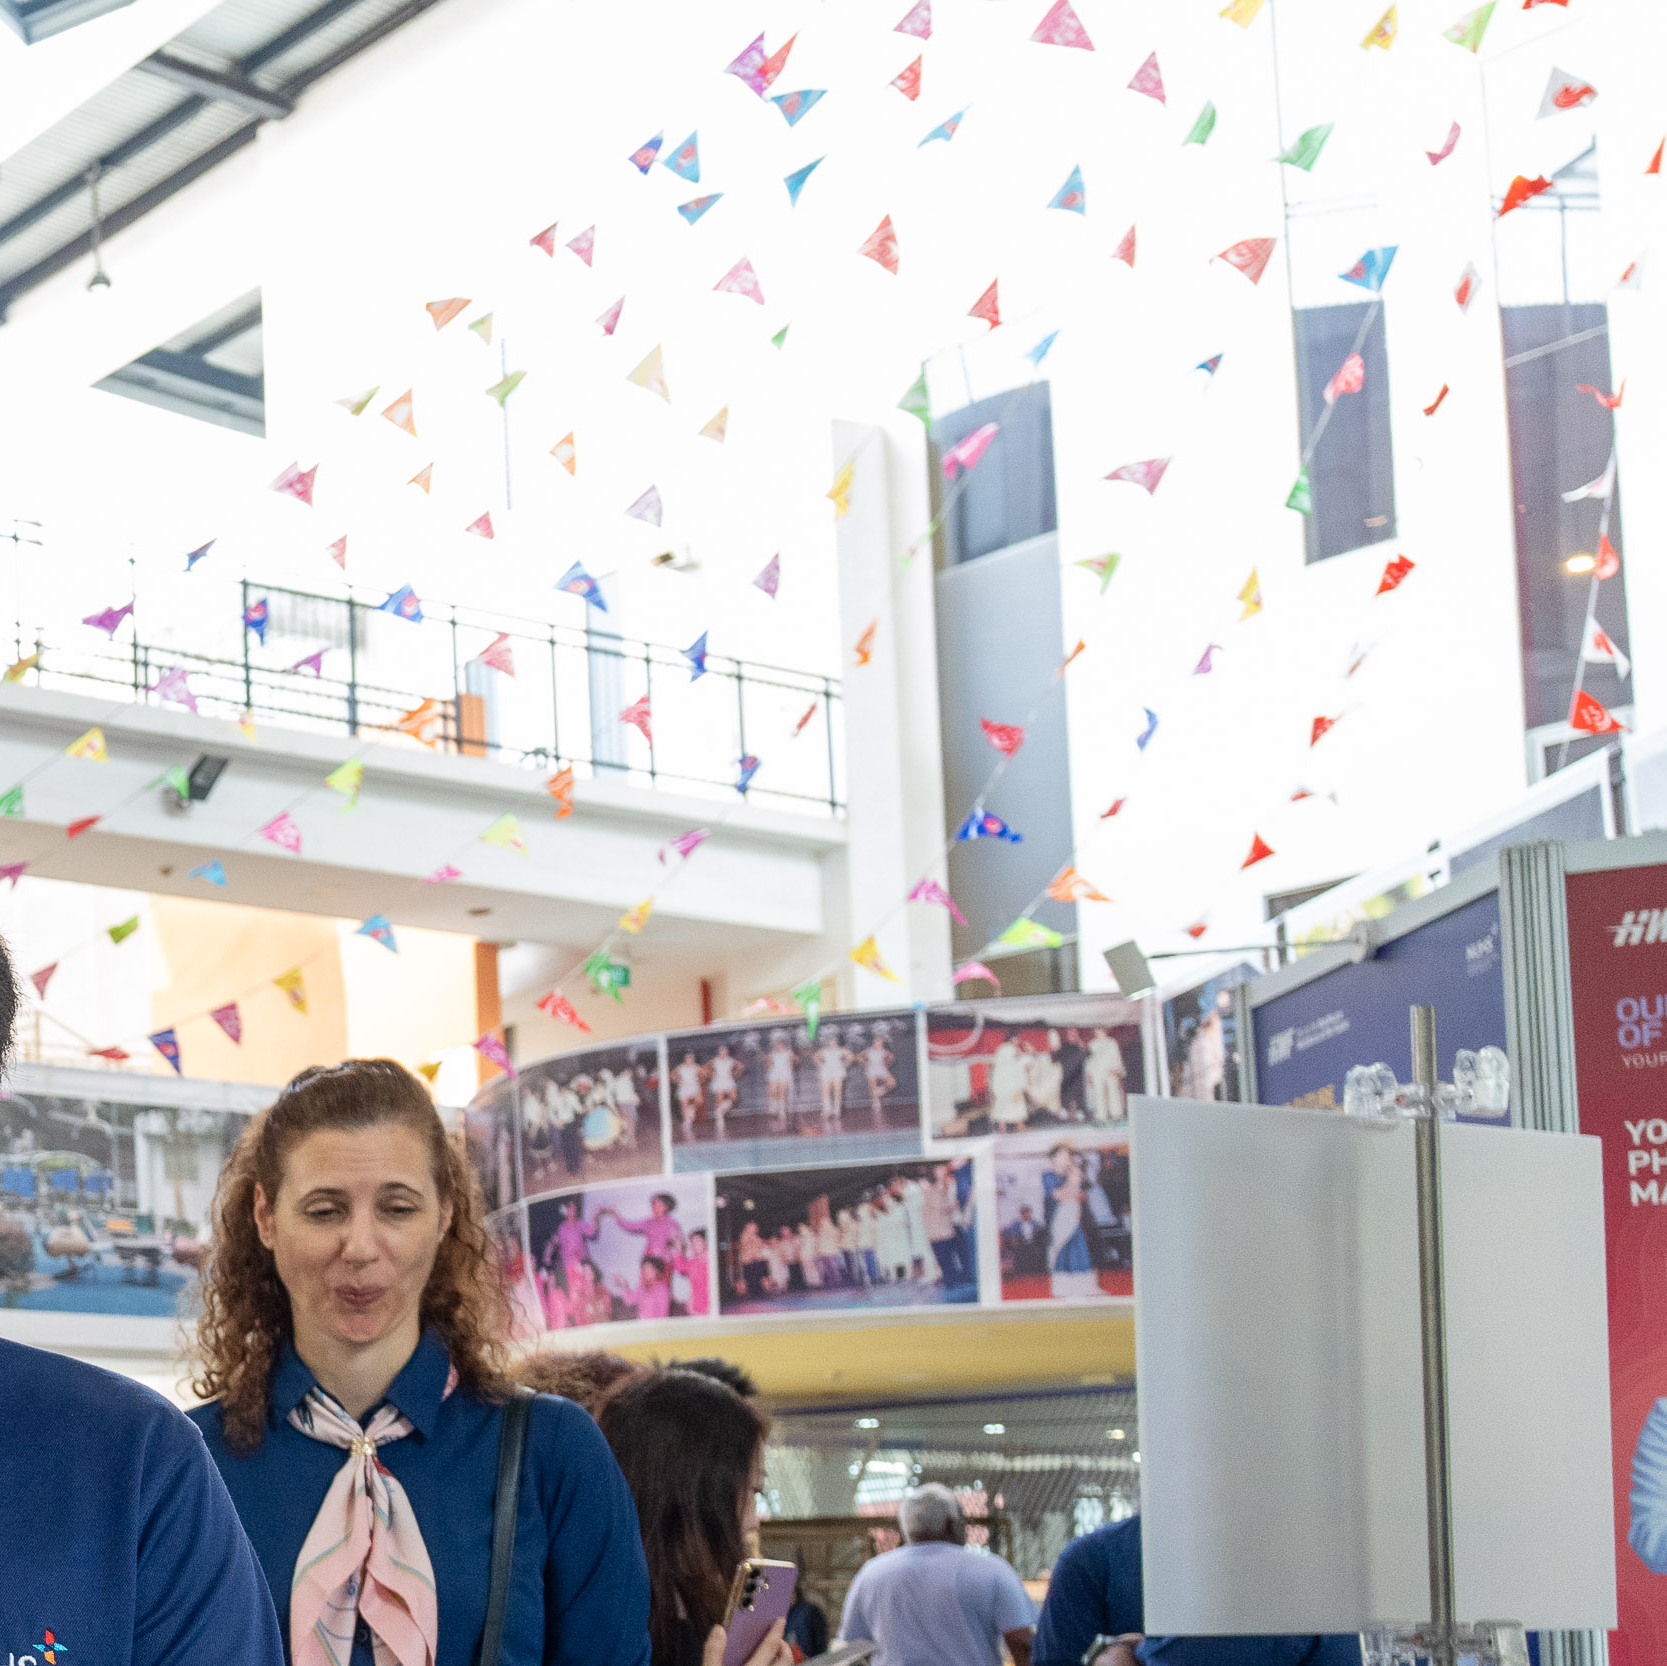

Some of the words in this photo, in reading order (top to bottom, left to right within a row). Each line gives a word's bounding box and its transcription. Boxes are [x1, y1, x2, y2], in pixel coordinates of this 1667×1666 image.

[1616, 994, 1667, 1024] OU
[1617, 1020, 1663, 1048] OF
[1623, 1117, 1667, 1146] YO
[1627, 1147, 1667, 1176] PH
